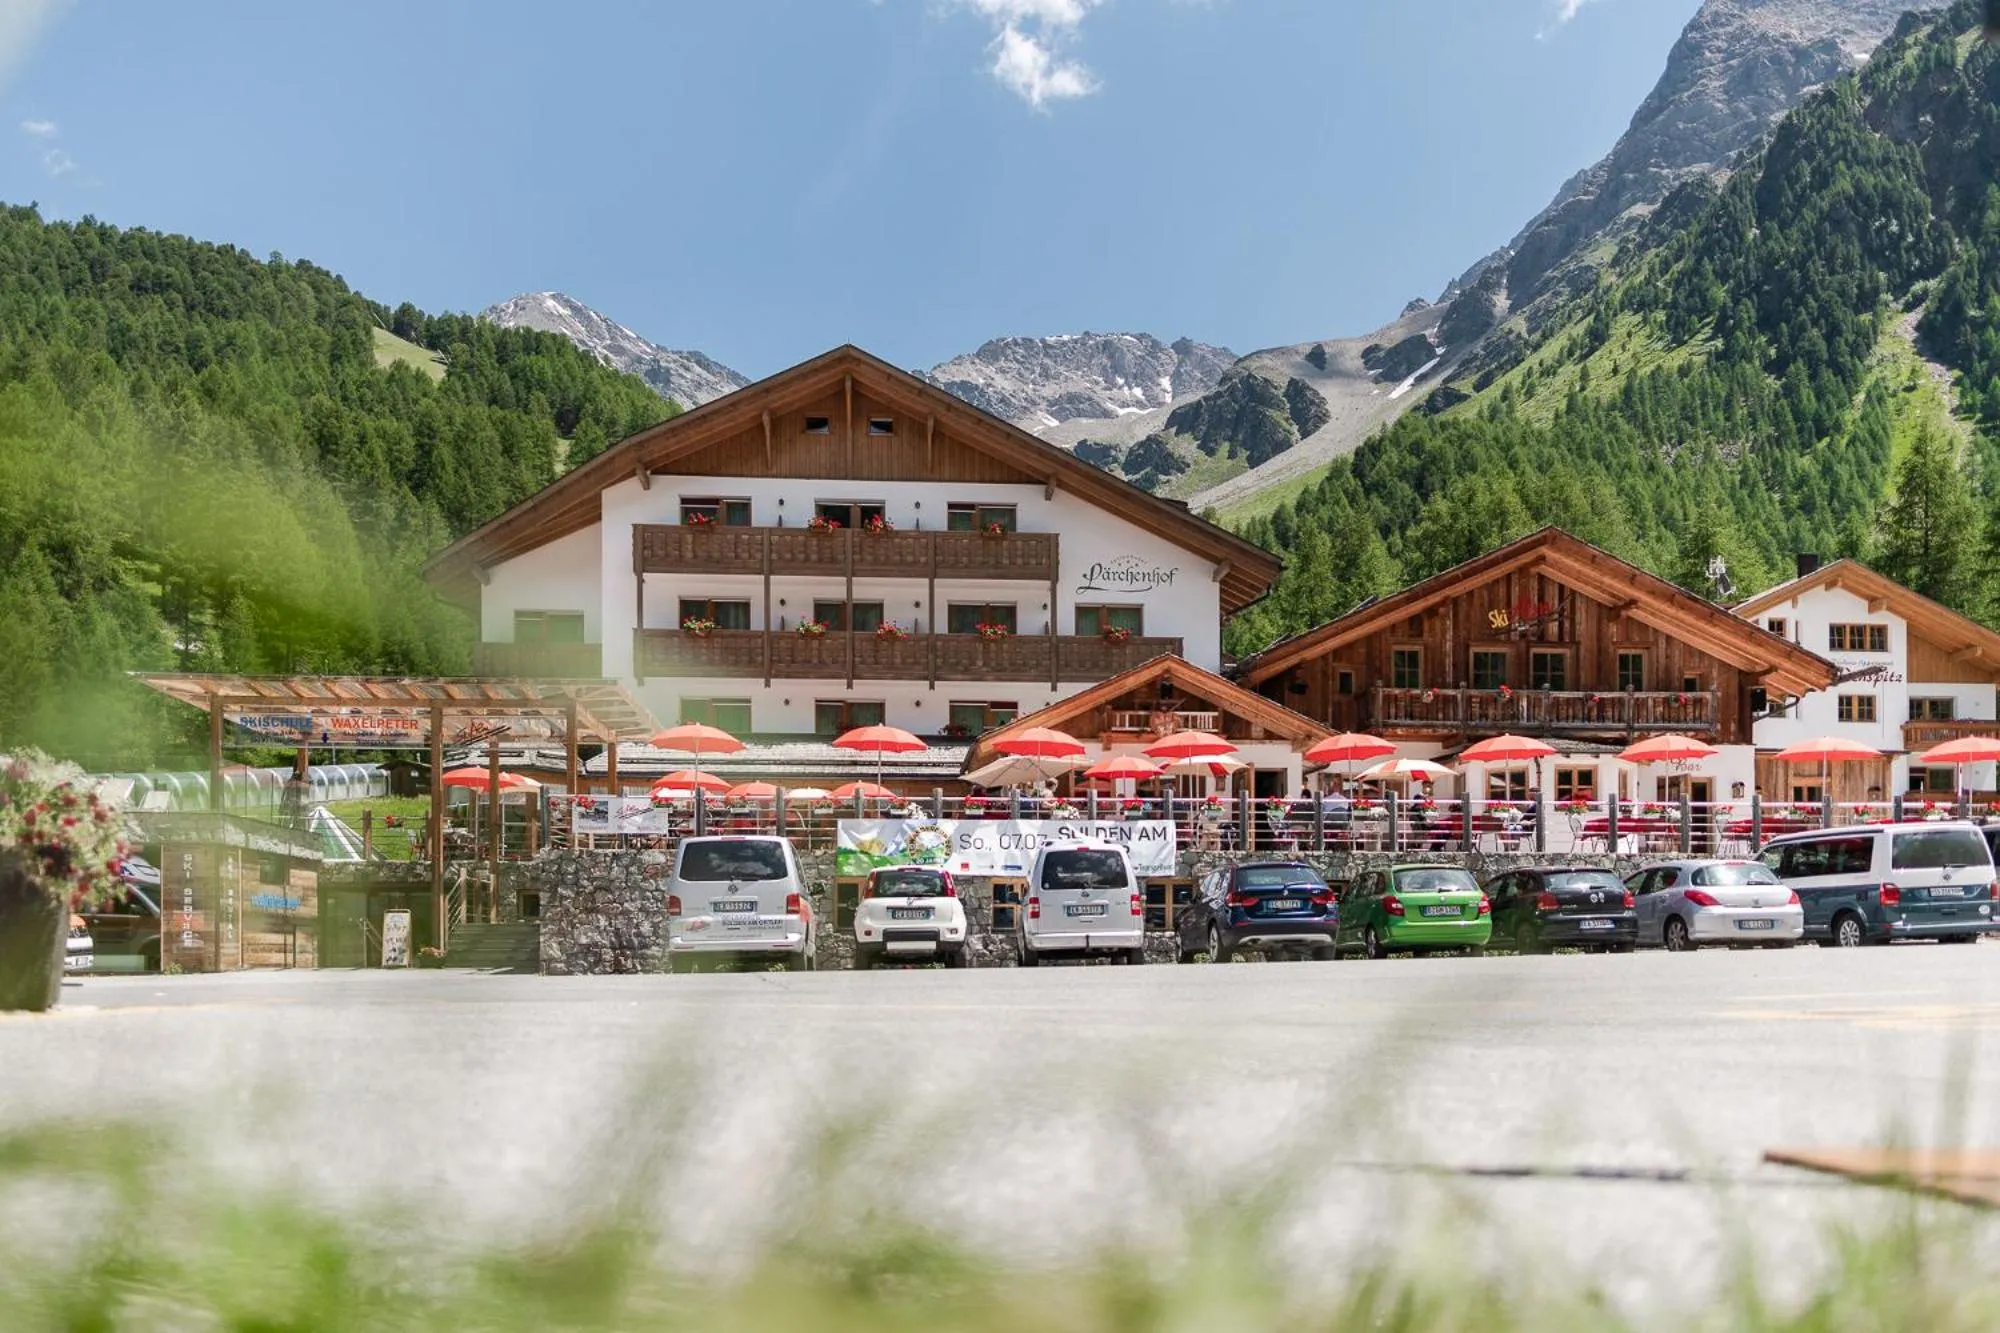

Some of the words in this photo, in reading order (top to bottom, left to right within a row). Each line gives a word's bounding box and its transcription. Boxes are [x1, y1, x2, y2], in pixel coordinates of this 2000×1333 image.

[1077, 563, 1179, 593] Lärchenhof
[1488, 609, 1509, 629] Ski
[240, 716, 313, 728] SKISCHULE
[331, 717, 419, 729] WAXELPETER
[1138, 826, 1167, 841] AM
[183, 853, 193, 880] SKI
